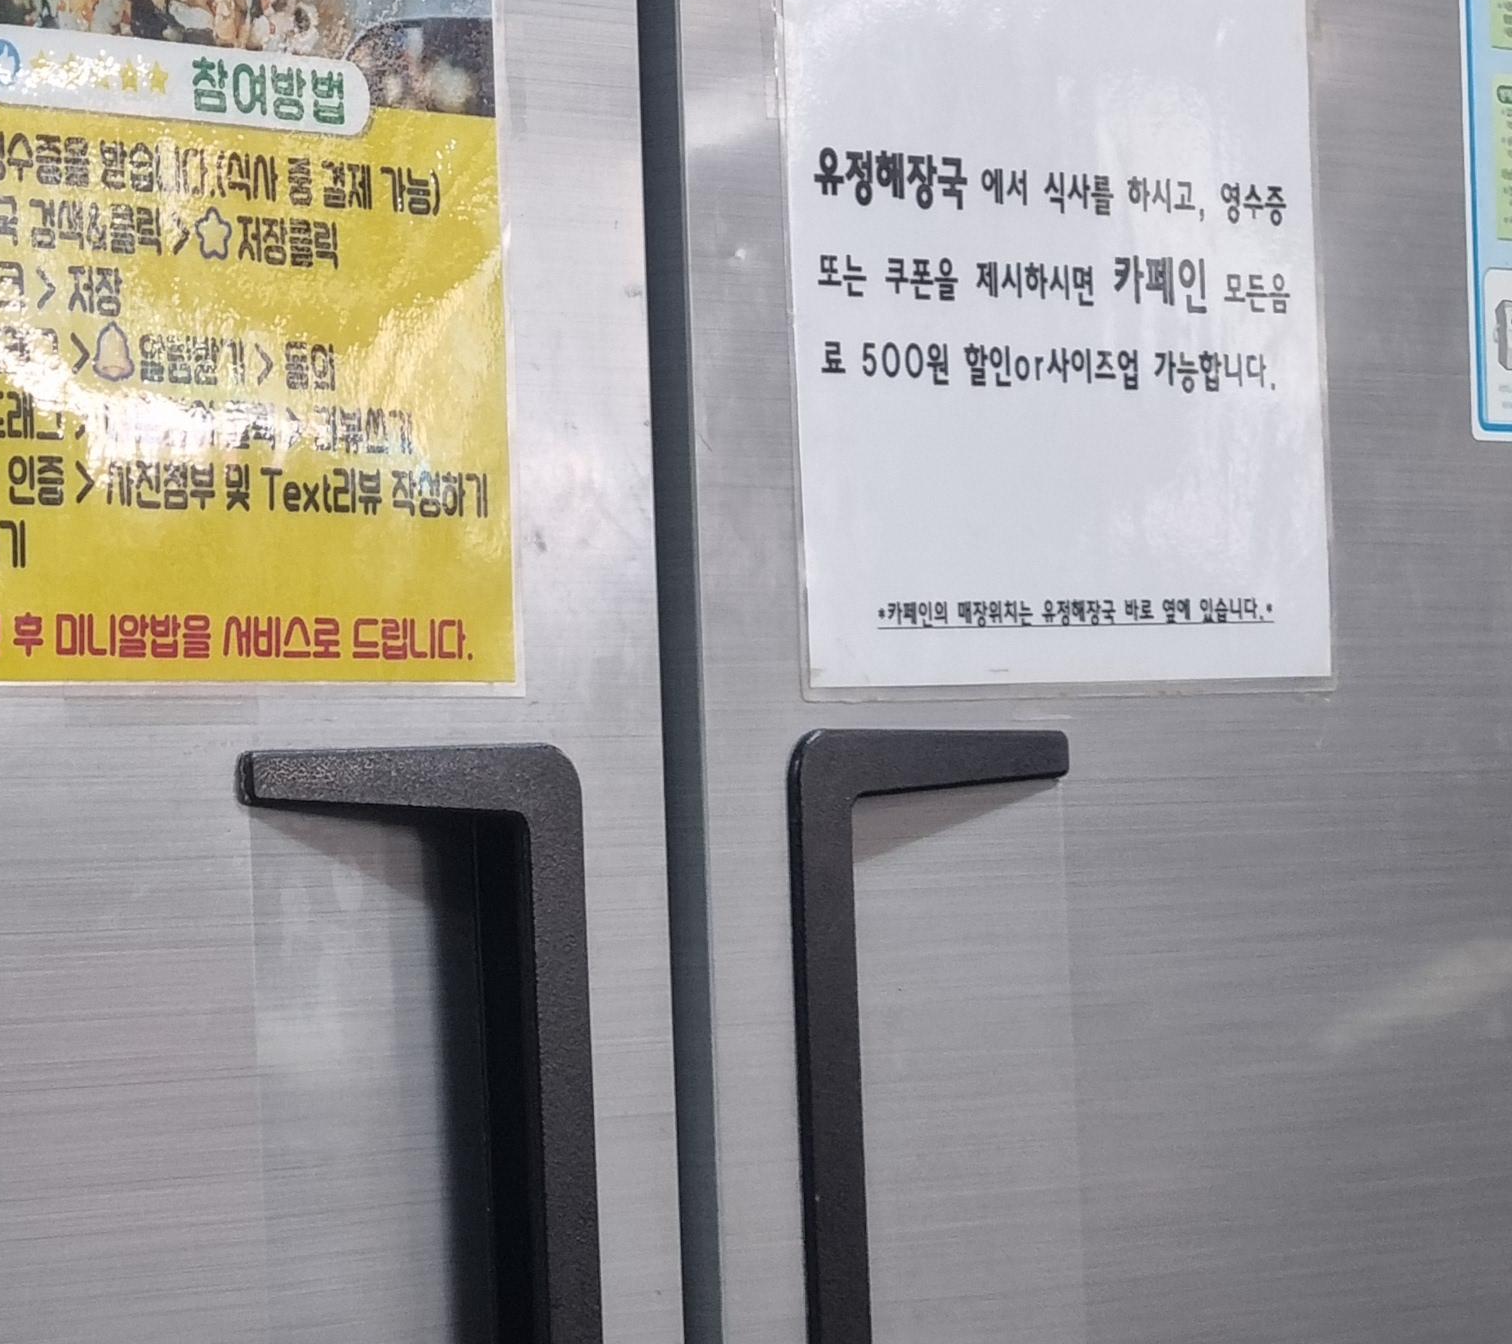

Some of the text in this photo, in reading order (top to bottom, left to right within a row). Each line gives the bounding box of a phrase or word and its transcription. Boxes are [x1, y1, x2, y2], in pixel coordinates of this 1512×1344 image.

[191, 56, 346, 127] 참여방법
[288, 156, 312, 208] 중
[321, 159, 372, 210] 결제
[380, 166, 441, 217] 가능)
[813, 147, 1287, 227] 유정해장국 에서 식사를 하시고, 영수증
[68, 264, 123, 317] 저장
[817, 254, 1291, 315] 또는 쿠폰을 제시하시면 카페인 모든음
[821, 341, 1276, 394] 료 500원 할인or사이즈업 가능합니다.
[8, 455, 65, 506] 인증
[224, 463, 250, 512] 및
[260, 467, 382, 515] Text리뷰
[392, 470, 488, 518] 작성하기
[13, 611, 43, 657] 후
[55, 613, 212, 660] 미니알밥을
[223, 615, 341, 660] 서비스로
[352, 617, 474, 662] 드립니다.
[958, 599, 1033, 627] 매장위치는
[1042, 599, 1116, 626] 유정해장국
[1125, 599, 1154, 622] 바로
[1162, 598, 1191, 624] 옆에
